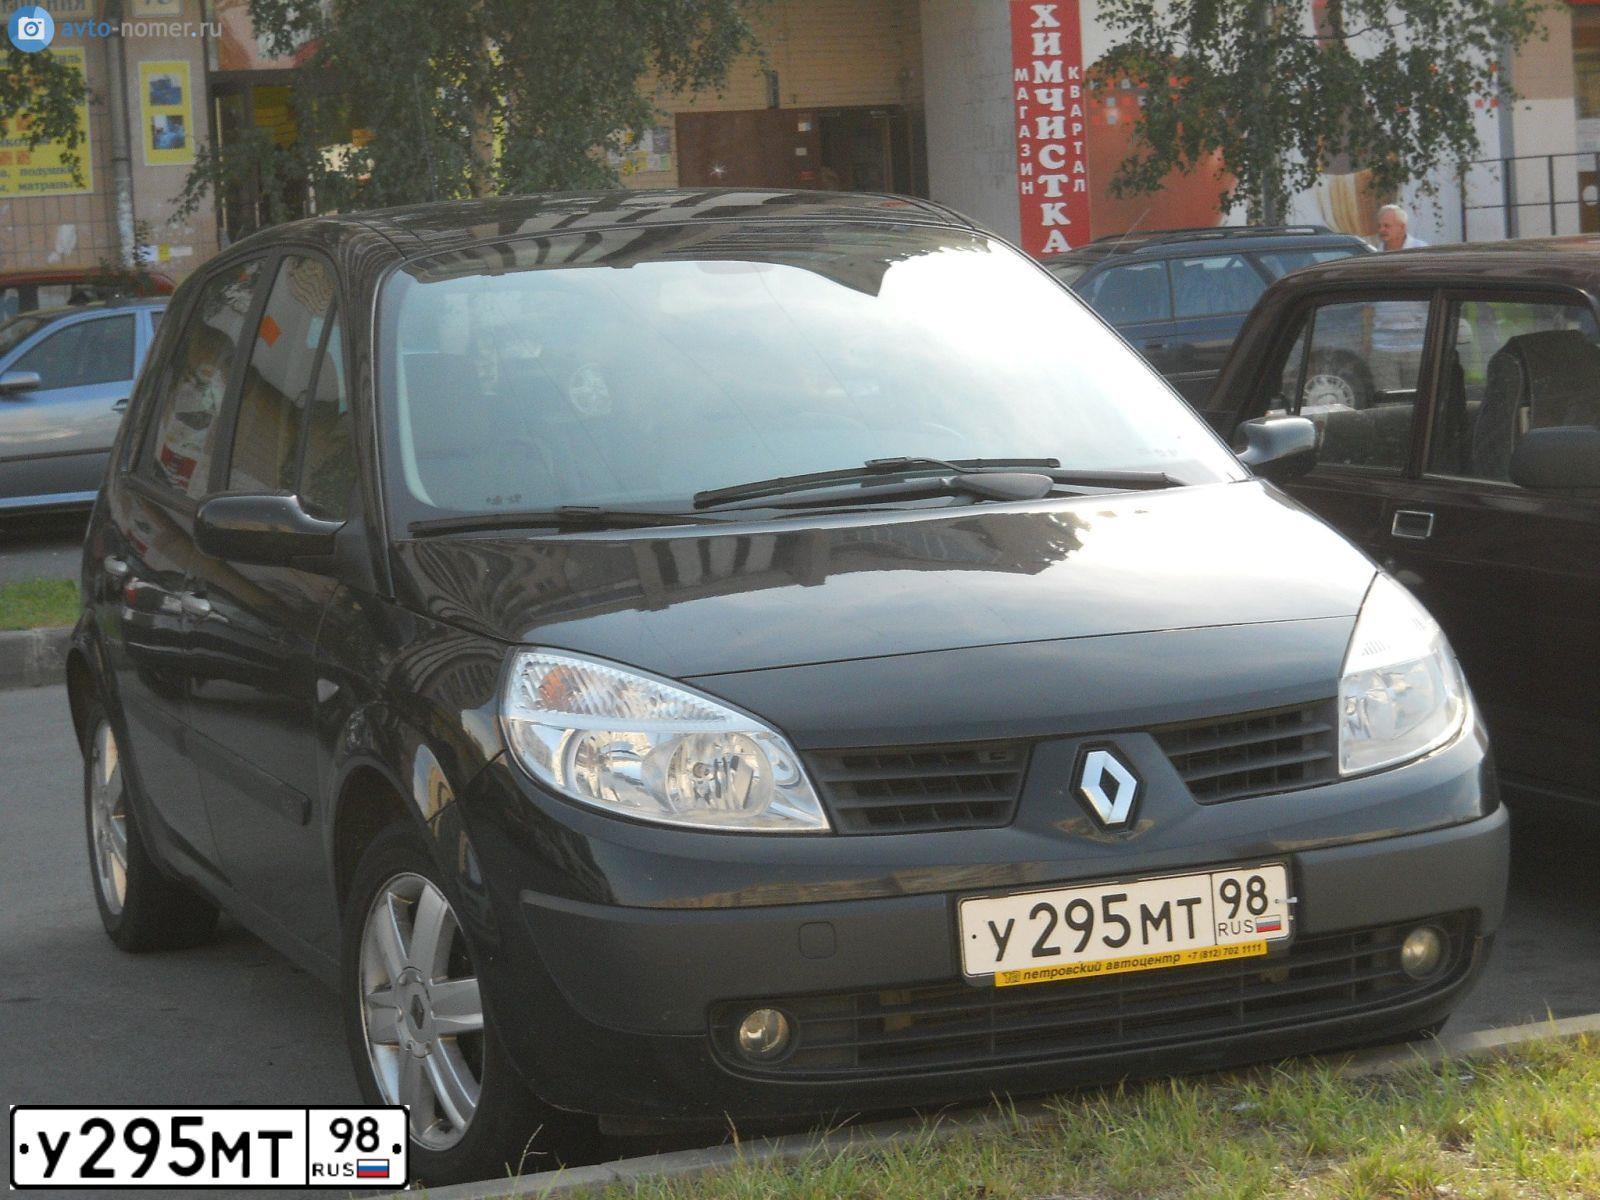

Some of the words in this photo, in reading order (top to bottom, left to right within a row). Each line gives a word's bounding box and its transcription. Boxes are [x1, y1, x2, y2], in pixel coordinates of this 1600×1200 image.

[1014, 67, 1034, 195] МАГАЗИН
[1030, 4, 1073, 253] ХИМЧИСТКА
[1068, 66, 1086, 192] КВАРТАЛ
[988, 893, 1202, 962] У295МТ
[1219, 875, 1268, 920] 98
[1023, 961, 1102, 980] петровский
[1105, 953, 1181, 971] автоцентр
[1223, 945, 1239, 956] 702
[1241, 943, 1263, 954] 1111
[1217, 920, 1254, 937] RUS
